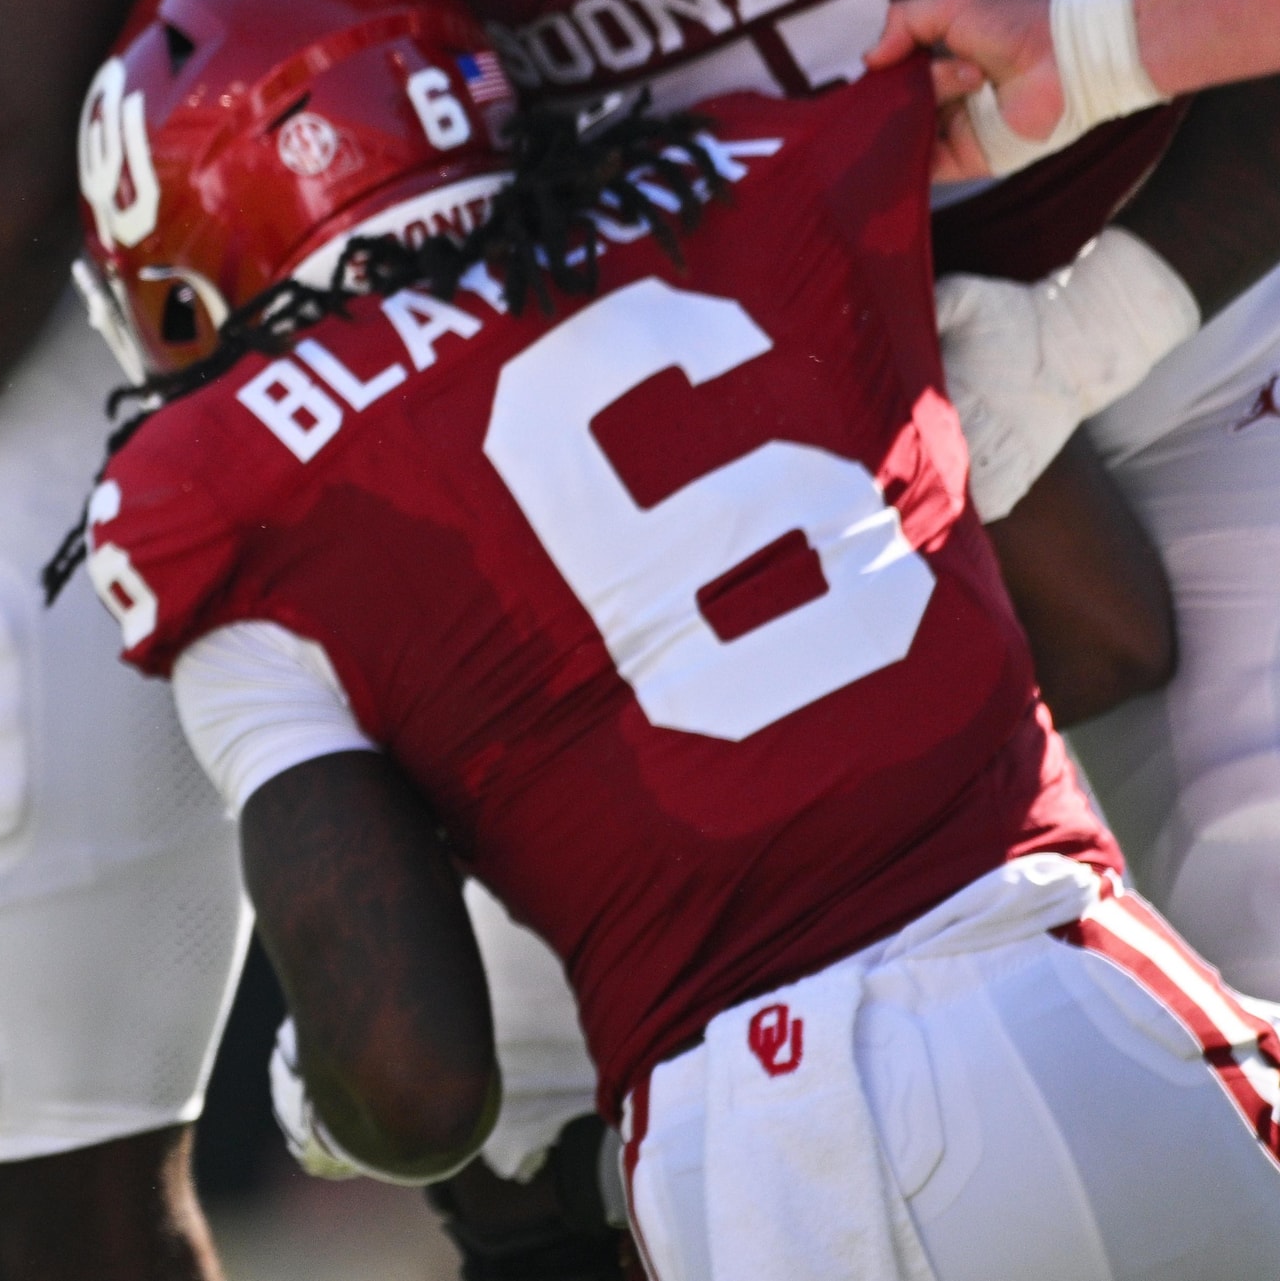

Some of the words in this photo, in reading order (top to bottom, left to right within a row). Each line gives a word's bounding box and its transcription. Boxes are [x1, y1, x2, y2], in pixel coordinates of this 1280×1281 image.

[406, 67, 472, 151] 6
[482, 275, 937, 742] 6
[747, 1002, 804, 1078] OU
